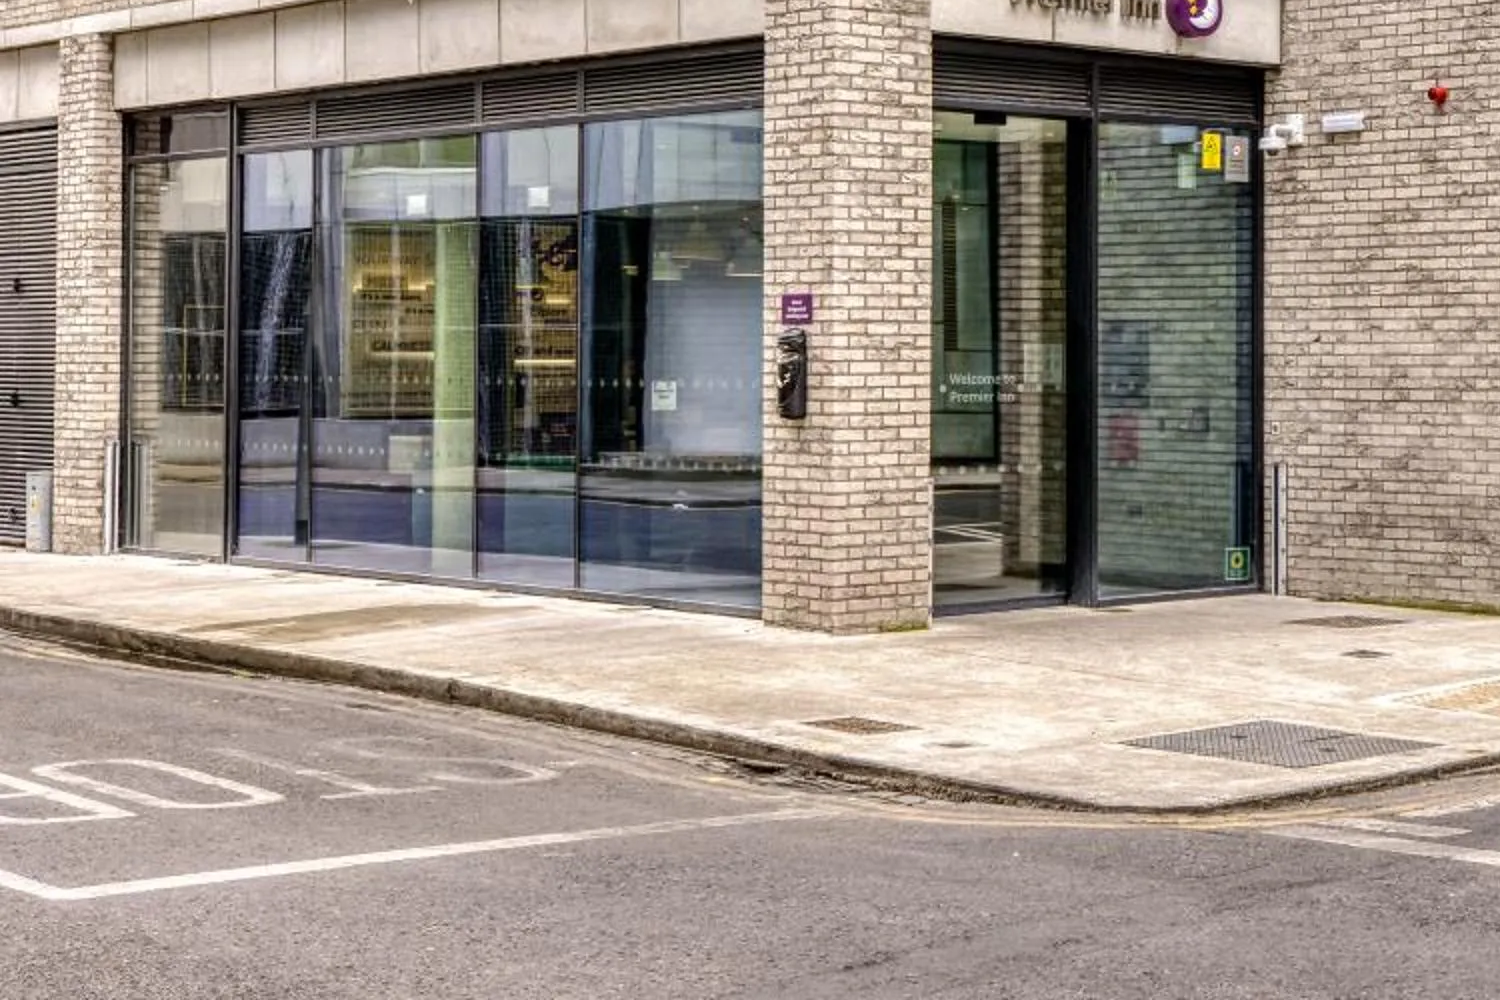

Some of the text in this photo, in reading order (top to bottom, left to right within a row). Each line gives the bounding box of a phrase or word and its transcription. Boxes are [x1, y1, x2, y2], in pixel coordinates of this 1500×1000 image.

[948, 371, 1016, 385] Welcome to
[948, 391, 1016, 404] Premier Inn
